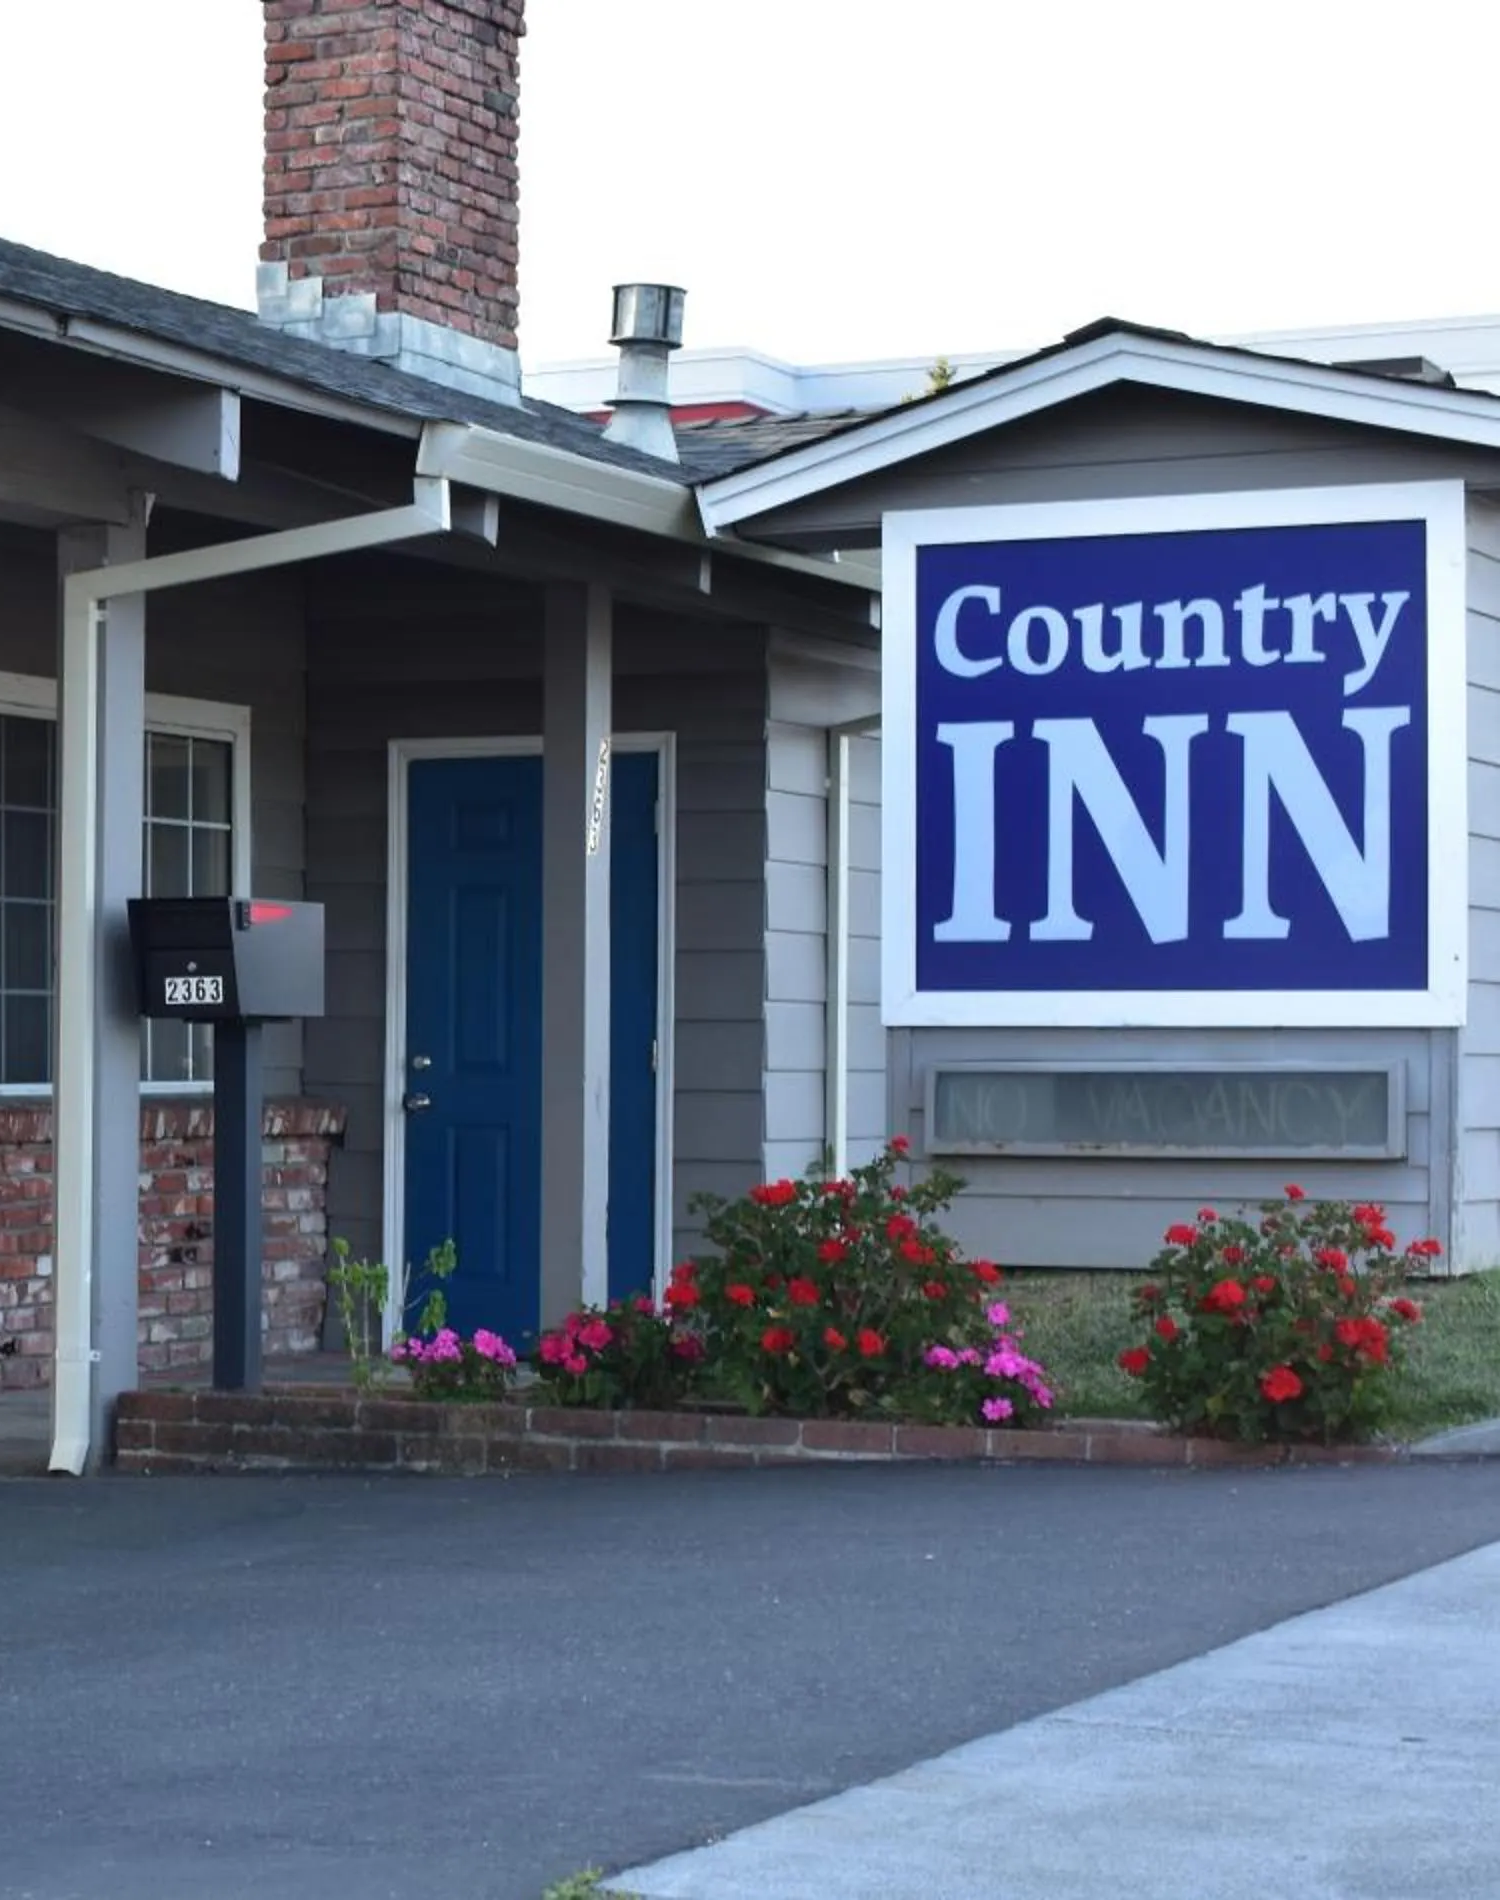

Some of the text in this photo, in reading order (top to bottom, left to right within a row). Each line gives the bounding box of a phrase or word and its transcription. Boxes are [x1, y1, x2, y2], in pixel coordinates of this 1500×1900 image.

[934, 583, 1411, 697] Country
[933, 705, 1411, 944] INN
[167, 977, 221, 1003] 2363
[949, 1079, 1028, 1141] NO
